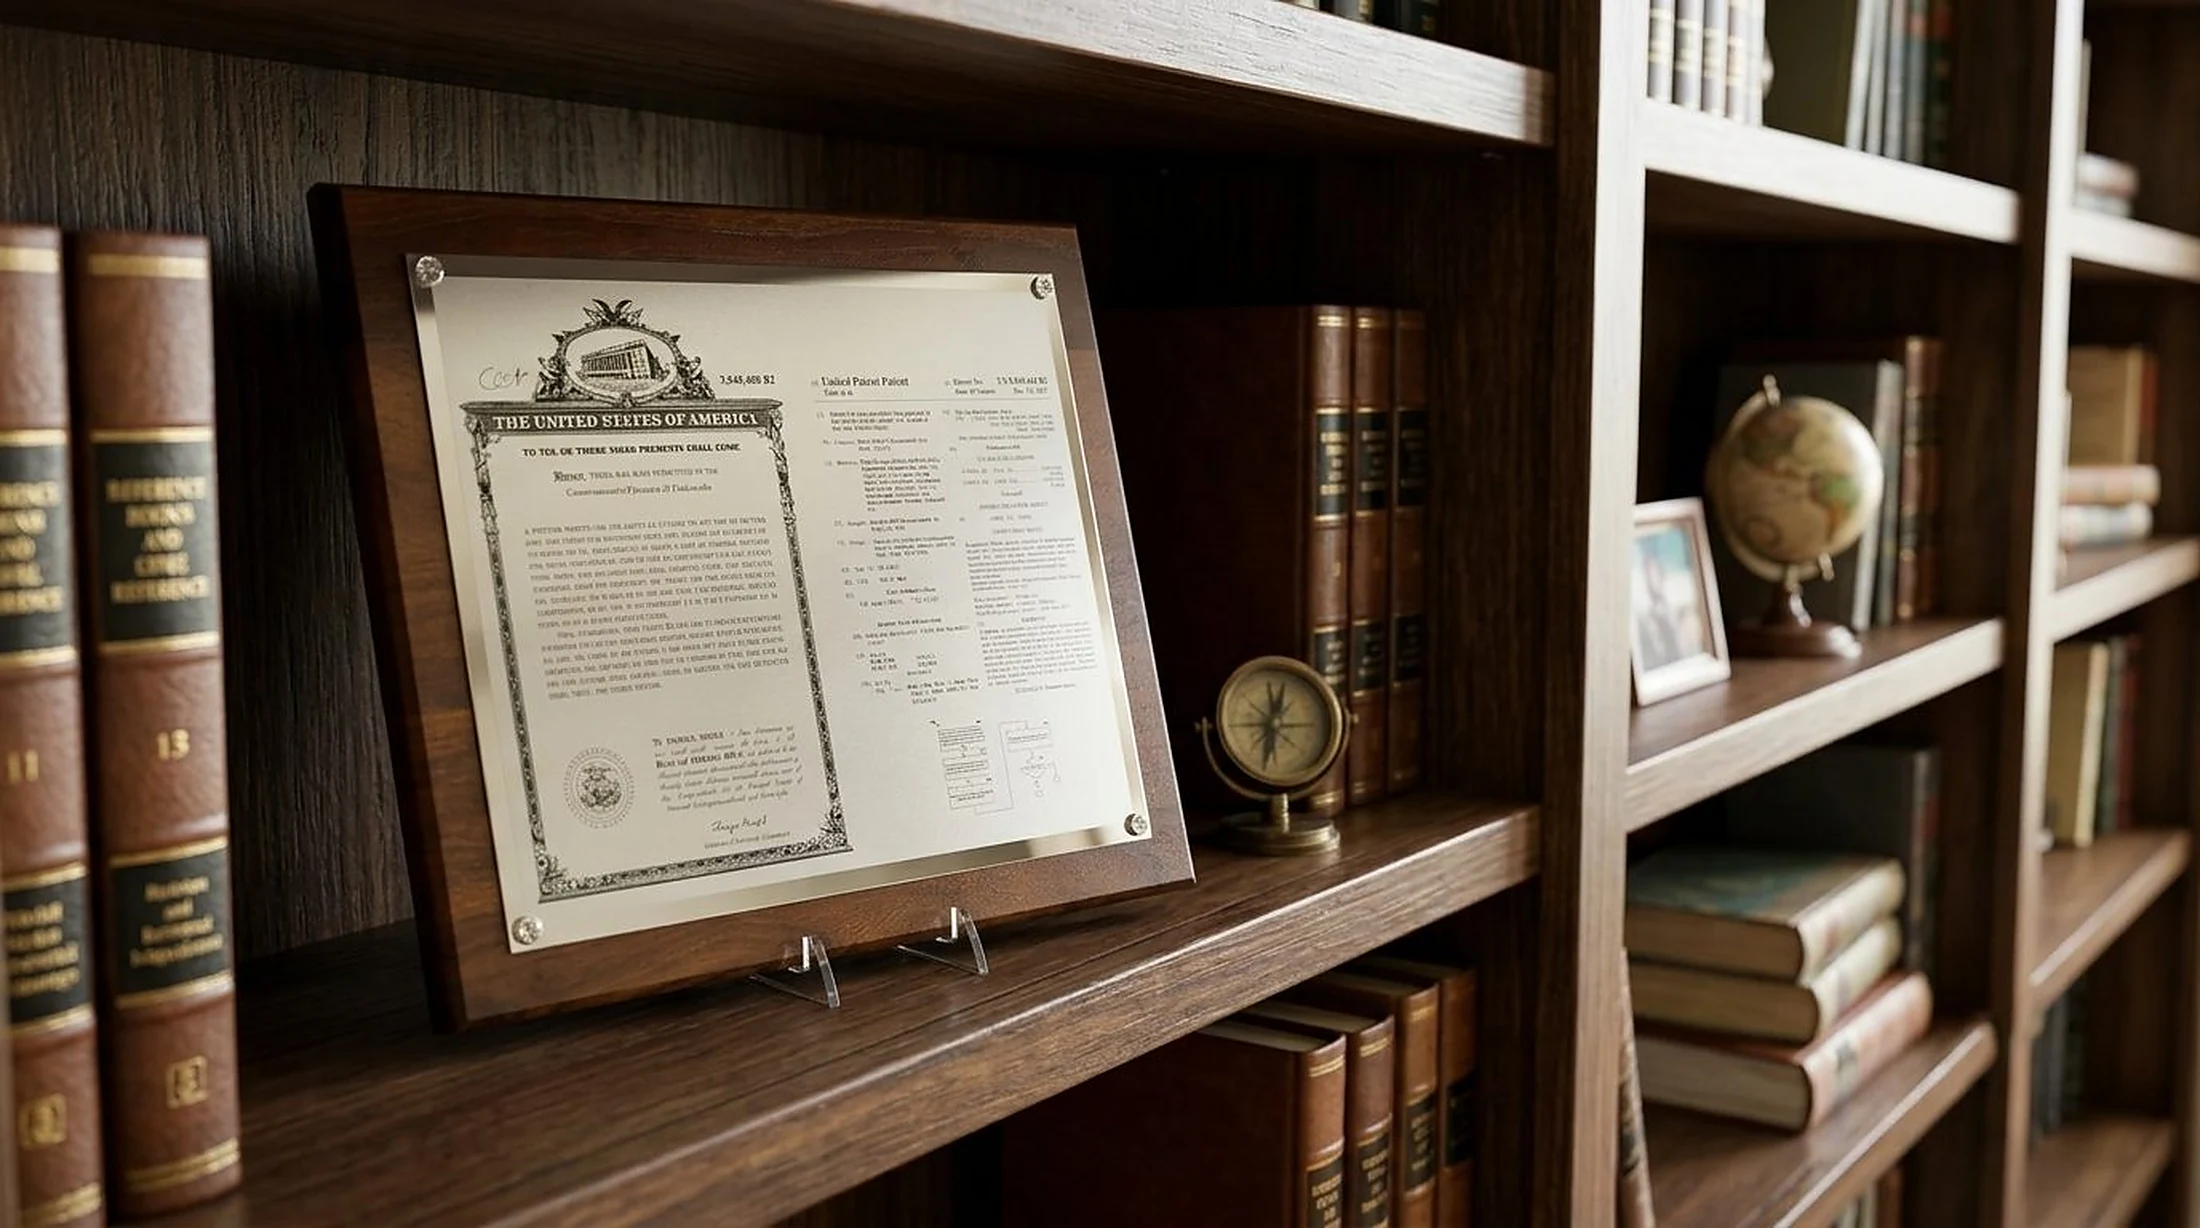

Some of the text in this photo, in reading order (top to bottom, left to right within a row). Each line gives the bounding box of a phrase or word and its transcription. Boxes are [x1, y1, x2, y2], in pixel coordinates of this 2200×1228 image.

[492, 416, 531, 430] THE
[534, 415, 599, 430] UNITED
[664, 413, 687, 427] OF
